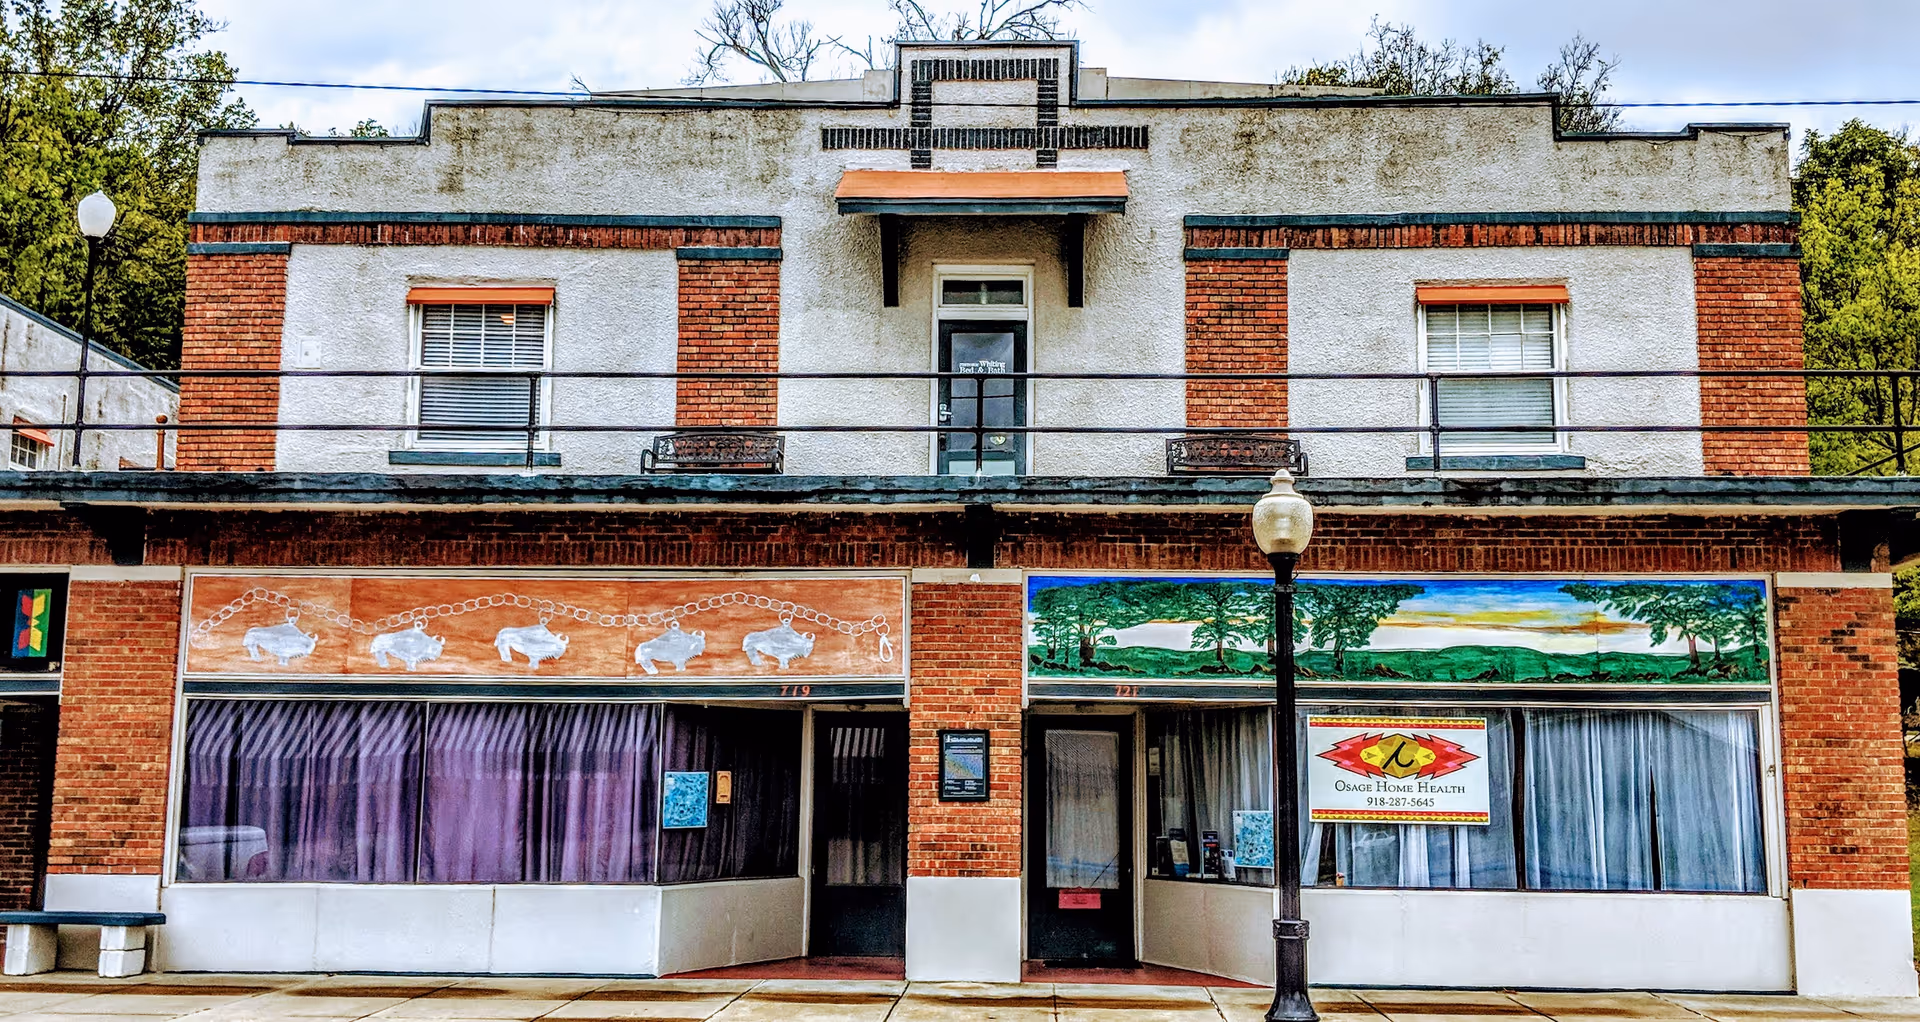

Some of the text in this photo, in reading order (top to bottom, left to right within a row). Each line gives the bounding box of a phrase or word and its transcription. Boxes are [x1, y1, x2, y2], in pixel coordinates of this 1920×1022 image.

[780, 685, 811, 697] 719
[1115, 685, 1138, 697] 721
[1366, 796, 1435, 807] 918-287-5645
